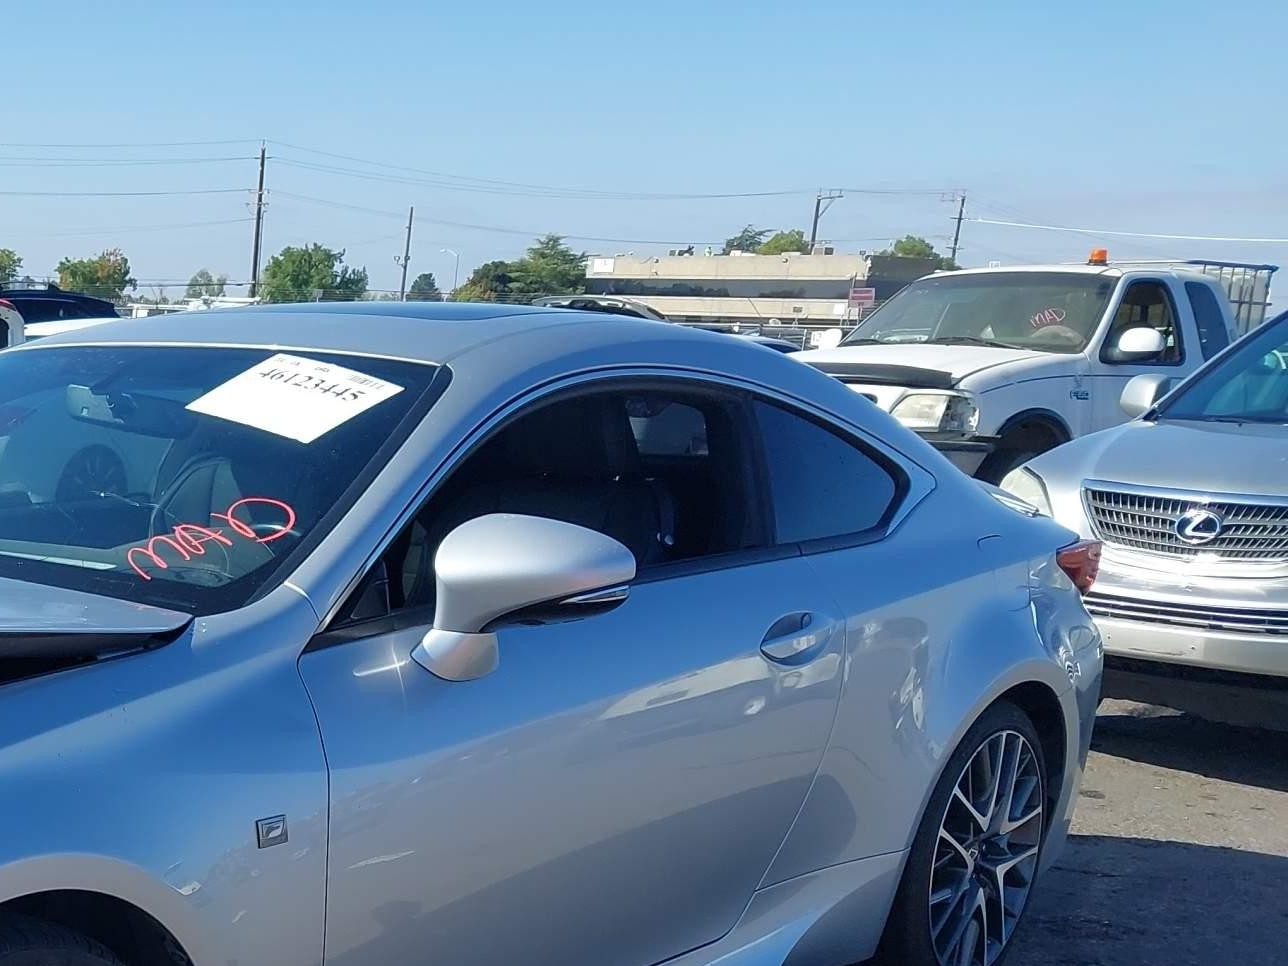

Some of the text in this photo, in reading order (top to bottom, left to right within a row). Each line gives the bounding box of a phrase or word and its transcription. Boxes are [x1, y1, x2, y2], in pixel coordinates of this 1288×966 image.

[1029, 308, 1066, 328] MAD
[259, 367, 366, 402] 46123445
[127, 497, 296, 581] MAD
